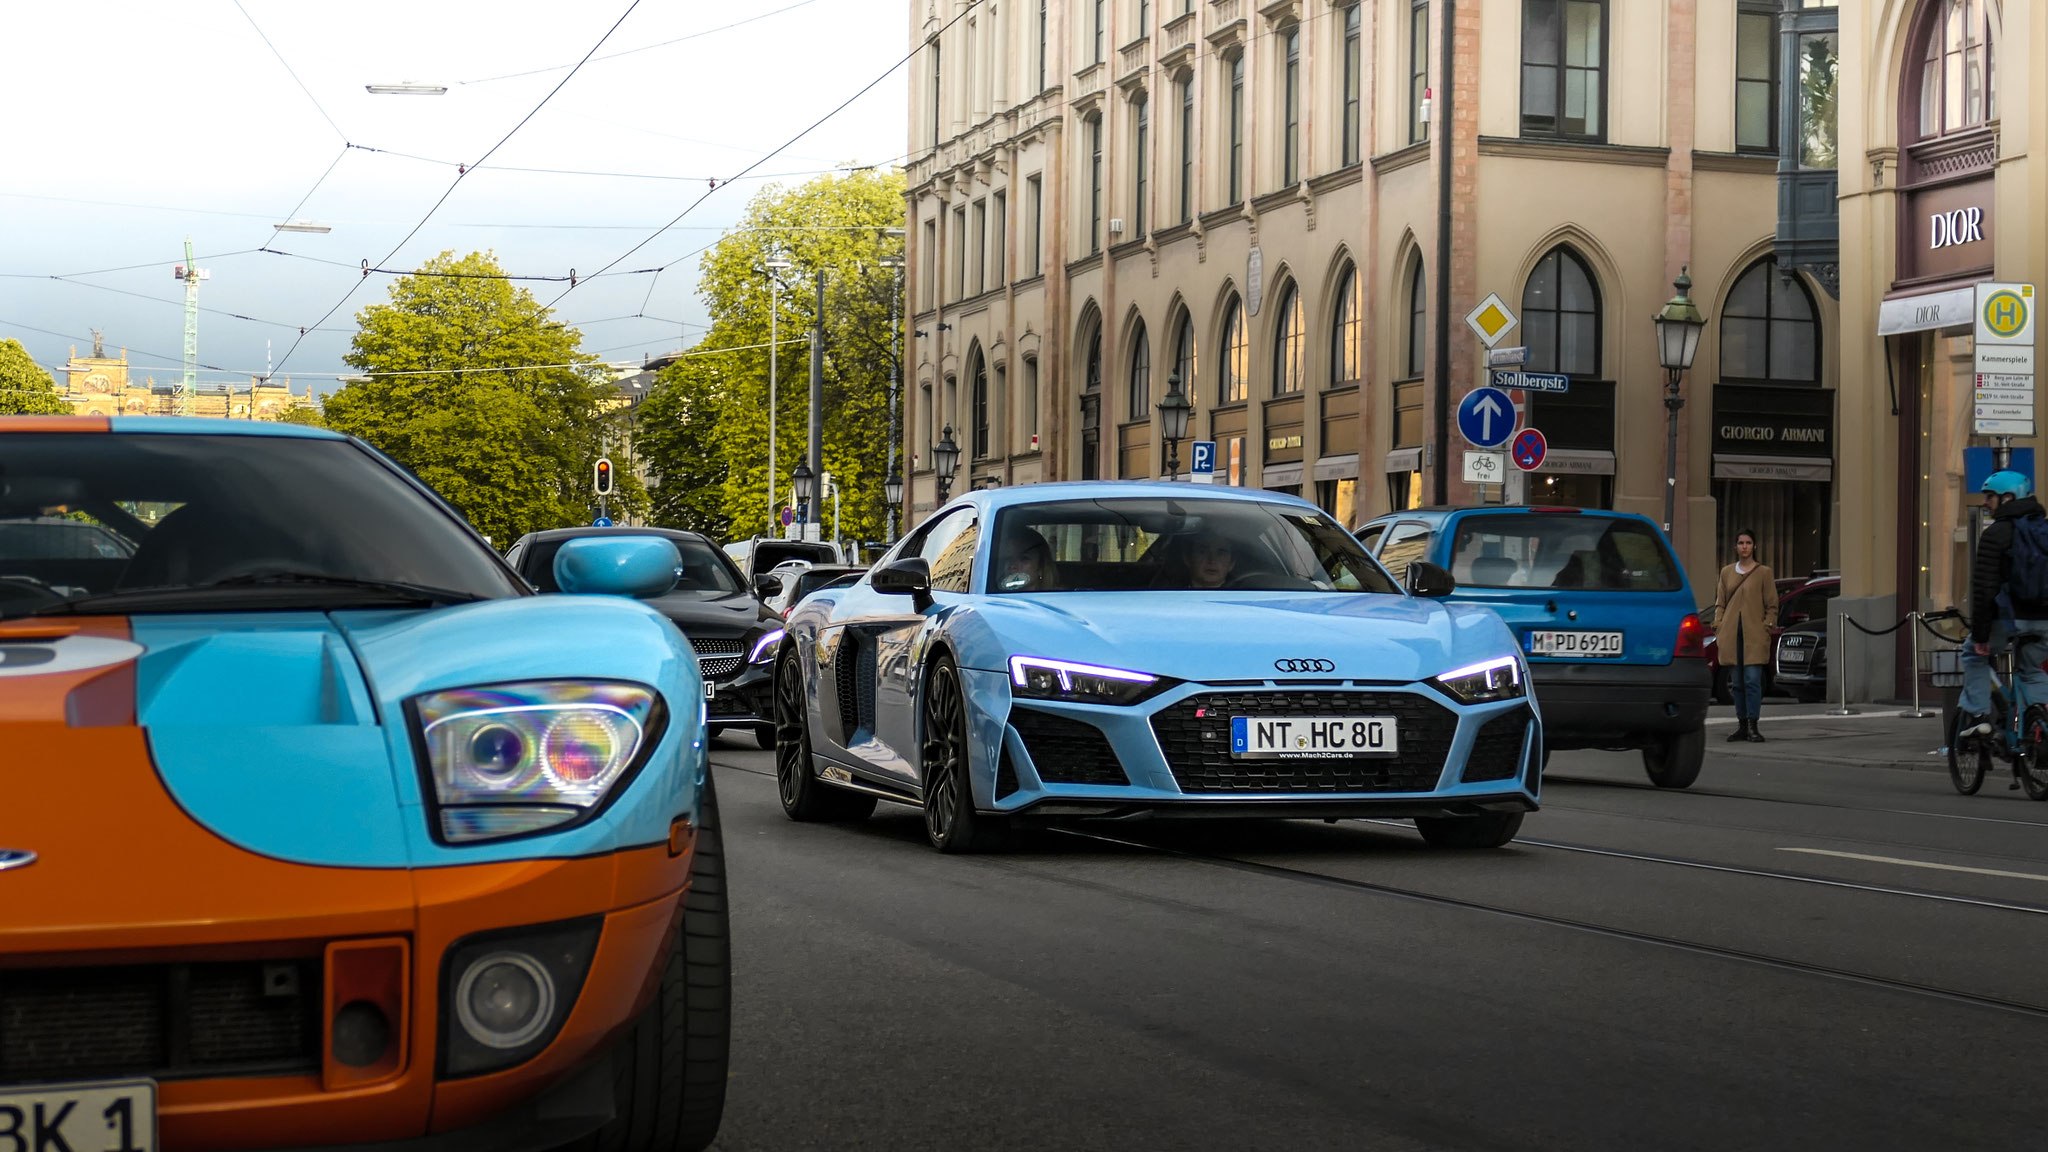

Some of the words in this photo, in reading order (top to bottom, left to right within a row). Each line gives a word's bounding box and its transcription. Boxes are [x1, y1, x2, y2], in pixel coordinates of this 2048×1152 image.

[1930, 206, 1982, 249] DIOR
[1915, 304, 1940, 324] DIOR
[1996, 302, 2016, 325] H
[1981, 355, 2028, 364] Kammerspiele
[1495, 372, 1565, 391] Stollbergstr.
[1721, 426, 1774, 440] GIORGIO
[1782, 428, 1824, 442] ARMANI
[1194, 445, 1208, 469] P
[1477, 472, 1491, 480] frei
[1532, 634, 1544, 650] M
[1555, 634, 1577, 650] PD
[1580, 635, 1620, 651] 6910
[703, 683, 713, 696] 0
[1237, 738, 1244, 747] D
[1257, 721, 1292, 748] NT
[1311, 721, 1345, 748] HC
[1351, 721, 1384, 748] 80
[103, 1097, 145, 1152] 1
